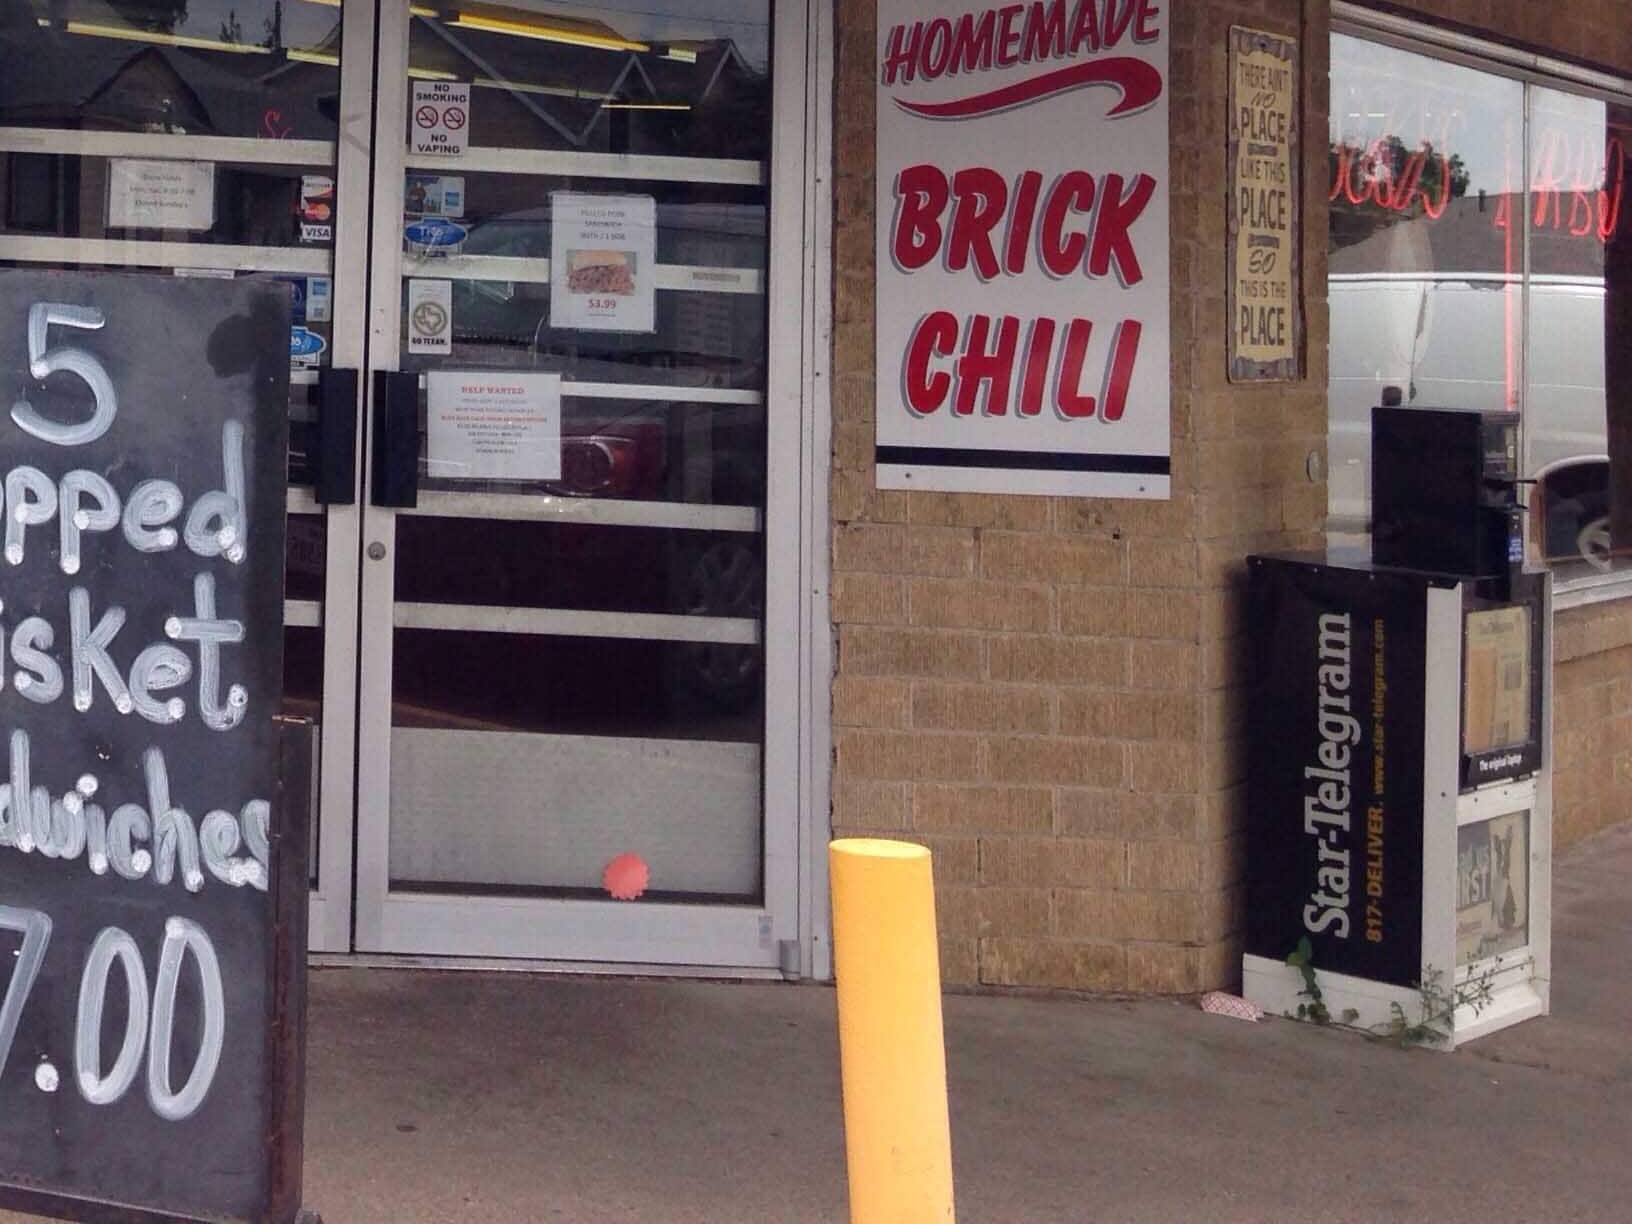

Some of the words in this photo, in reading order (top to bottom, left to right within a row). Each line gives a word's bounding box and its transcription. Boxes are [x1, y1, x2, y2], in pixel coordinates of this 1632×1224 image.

[433, 83, 450, 93] NO
[1240, 62, 1266, 89] THERE
[1268, 69, 1289, 93] AINT
[416, 92, 467, 103] SMOKING
[1251, 92, 1276, 109] NO
[1240, 107, 1285, 143] PLACE
[417, 143, 461, 154] VAPING
[431, 134, 448, 143] NO
[1240, 158, 1261, 181] LIKE
[1263, 159, 1285, 185] THIS
[1240, 188, 1286, 230] PLACE
[304, 226, 330, 238] VISA
[893, 164, 1157, 288] BRICK
[1248, 249, 1276, 275] SO
[1240, 279, 1259, 297] THIS
[1269, 280, 1287, 299] THE
[588, 298, 617, 310] $3.99
[1240, 307, 1285, 347] PLACE
[10, 301, 118, 446] 5
[903, 310, 1141, 422] CHILI
[1304, 612, 1361, 941] Star-Telegram
